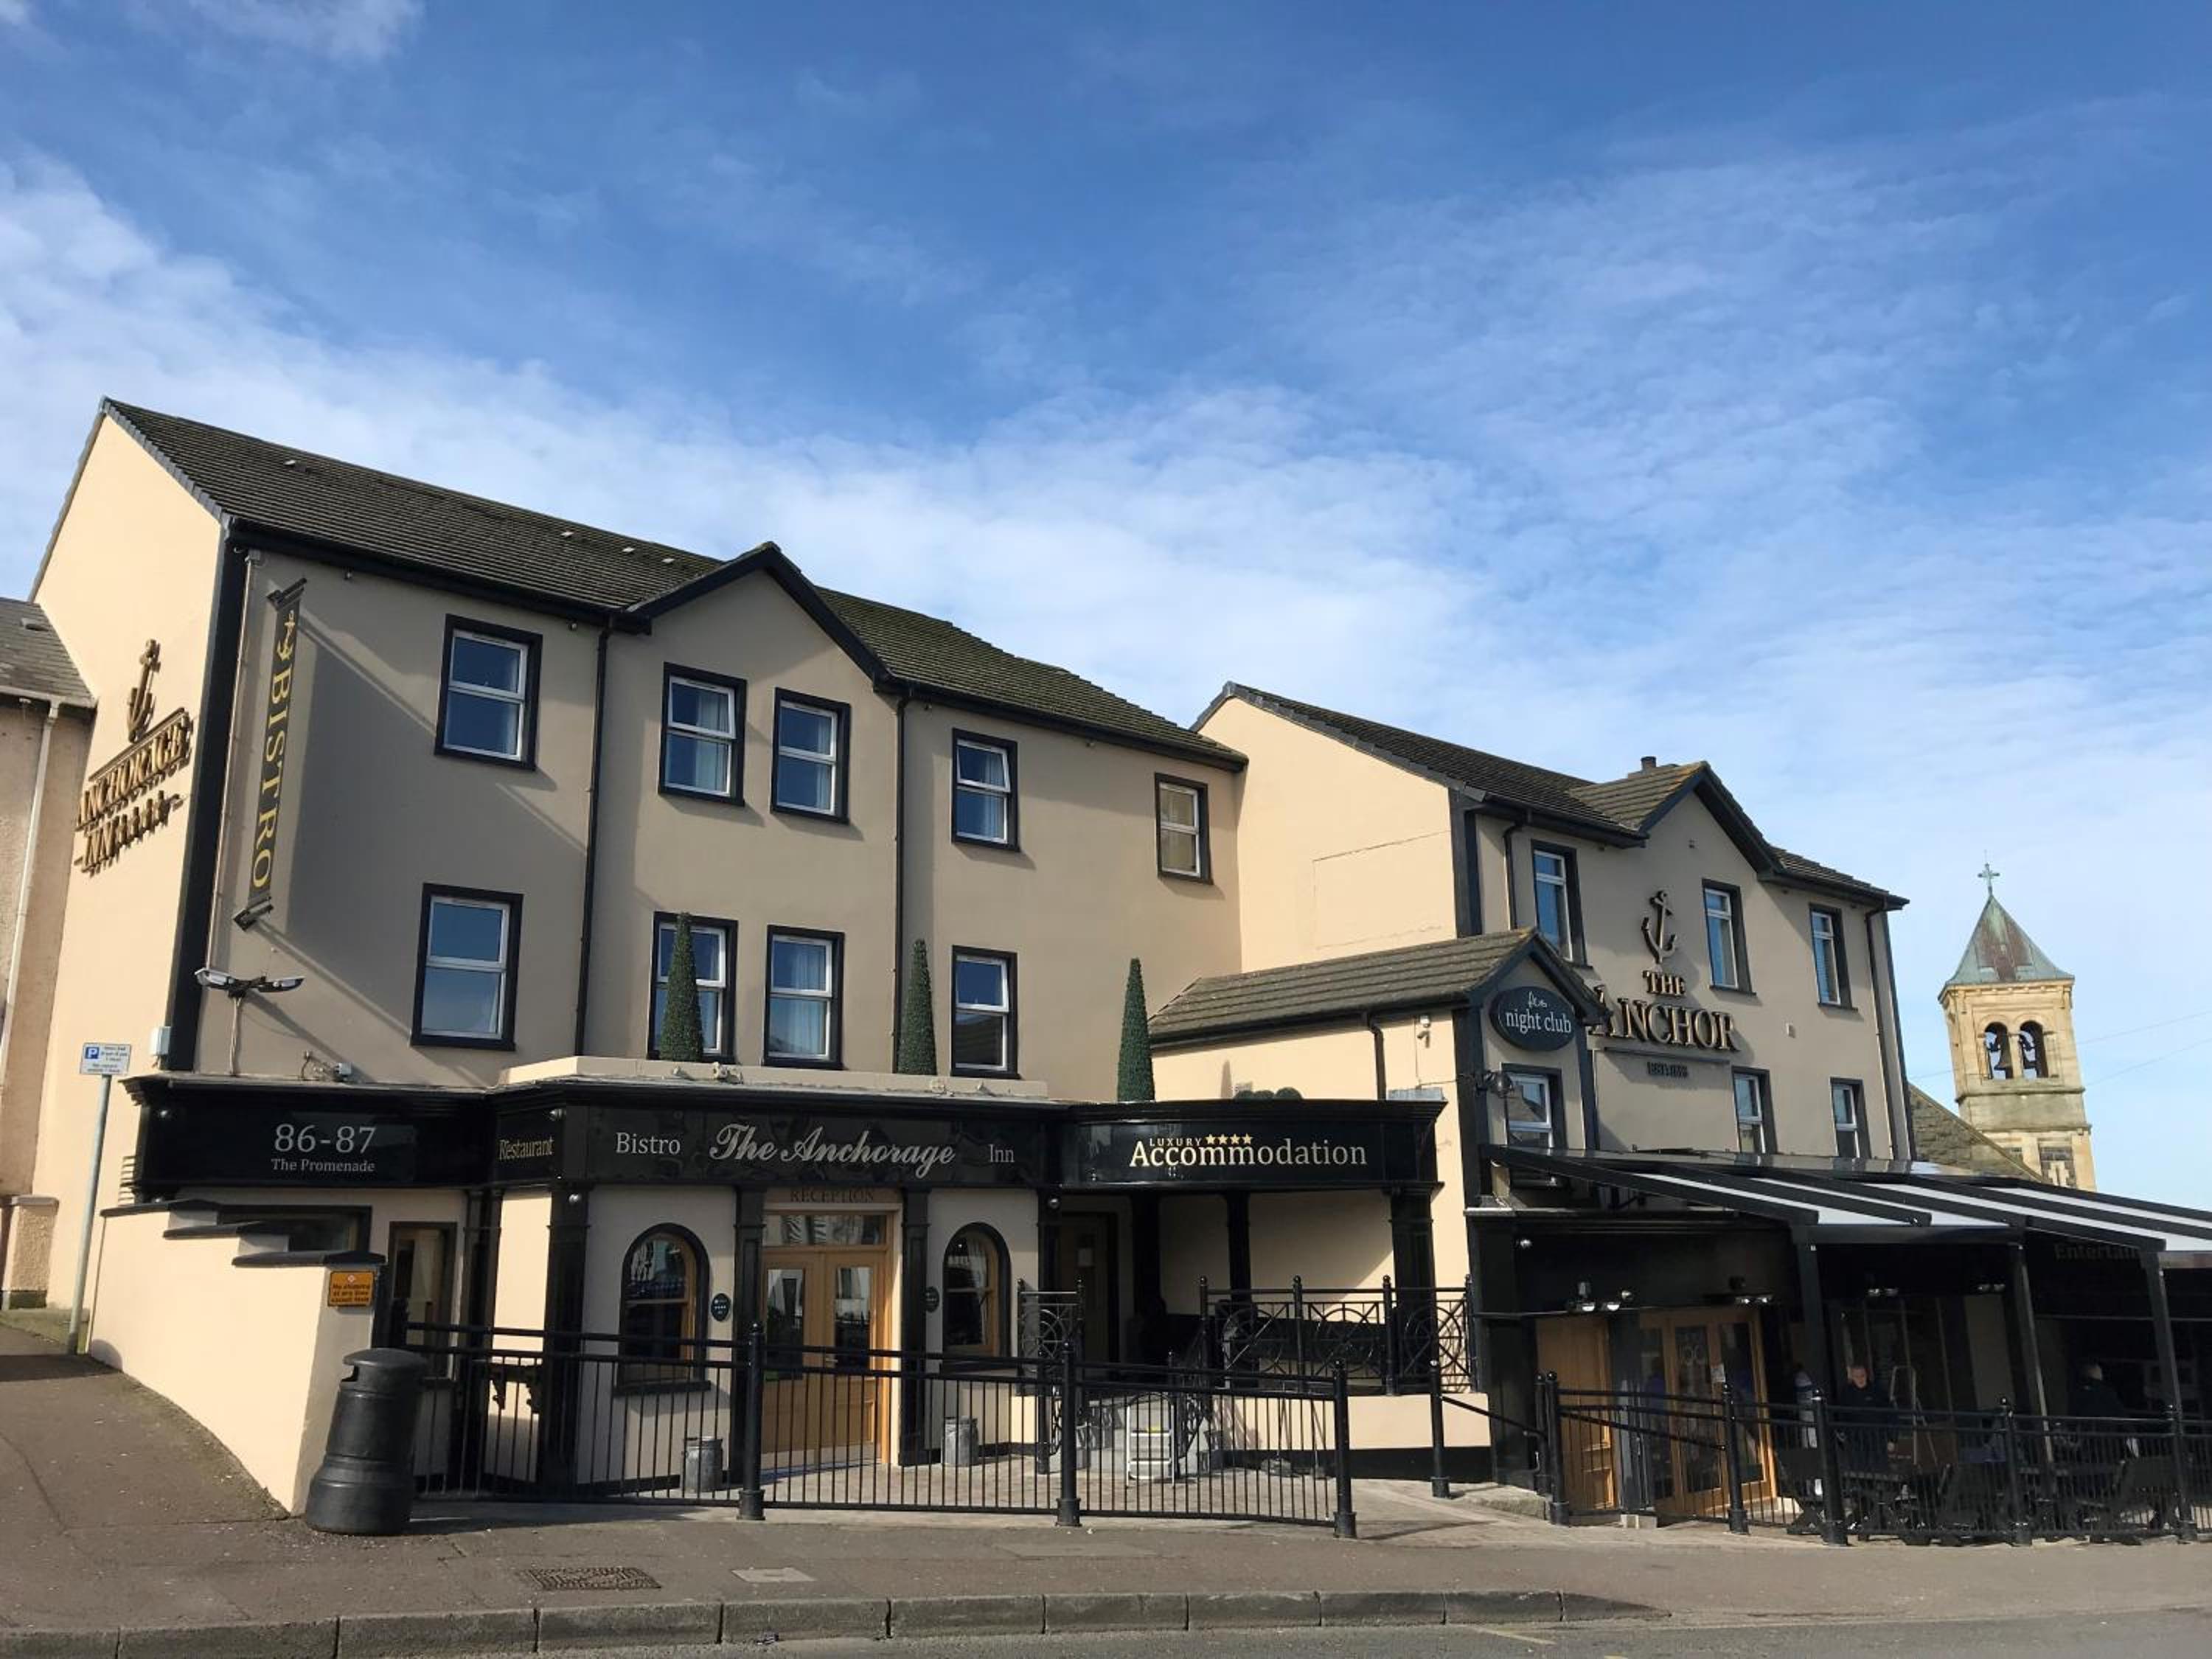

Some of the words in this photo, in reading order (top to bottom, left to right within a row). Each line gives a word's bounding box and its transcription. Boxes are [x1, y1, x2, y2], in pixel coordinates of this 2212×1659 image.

[252, 665, 292, 888] BISTRO
[1642, 970, 1686, 995] THE
[1506, 1008, 1542, 1034] night
[1544, 1011, 1571, 1033] club
[274, 1123, 377, 1154] 86-87
[498, 1136, 554, 1161] Restaurant
[615, 1131, 681, 1155] Bistro
[709, 1122, 778, 1162] The
[780, 1125, 957, 1178] Anchorage
[1149, 1137, 1202, 1147] LUXURY
[271, 1158, 297, 1171] The
[301, 1158, 375, 1172] Promenade
[989, 1144, 1015, 1164] Inn
[1129, 1138, 1368, 1168] Accommodation
[790, 1187, 874, 1203] RECEPTION
